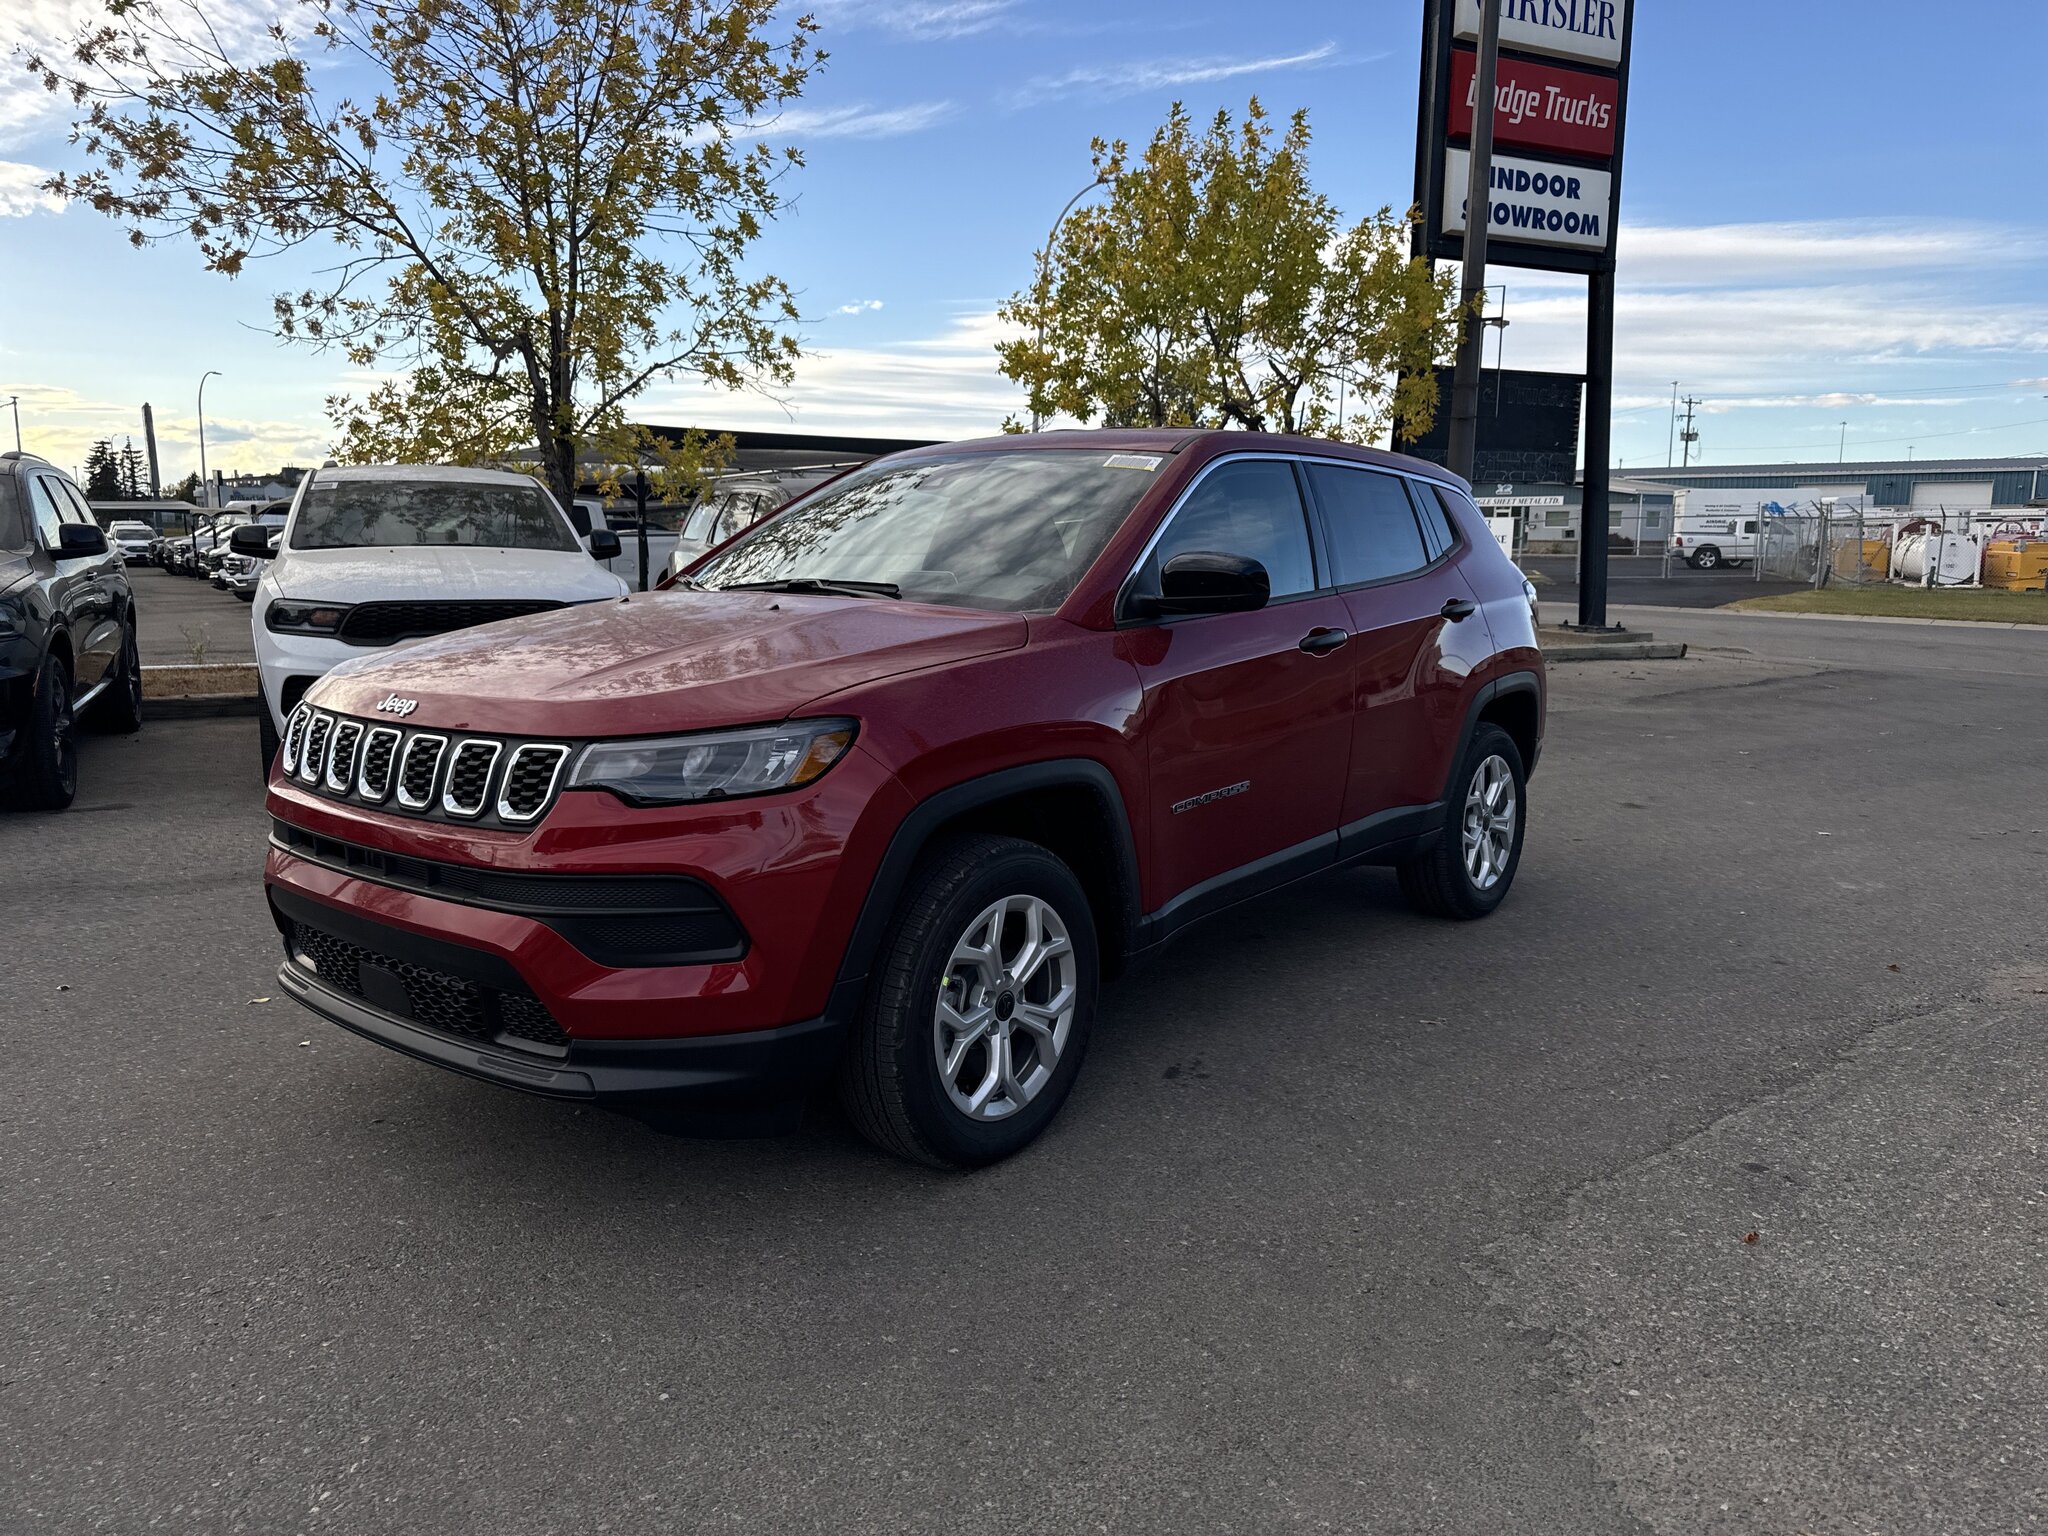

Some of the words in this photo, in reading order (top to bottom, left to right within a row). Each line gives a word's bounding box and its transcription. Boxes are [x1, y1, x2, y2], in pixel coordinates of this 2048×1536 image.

[1477, 0, 1616, 40] RYSLER
[1545, 85, 1612, 129] Trucks
[1489, 166, 1581, 200] INDOOR
[376, 692, 418, 718] Jeep
[1172, 780, 1251, 815] COMPASS
